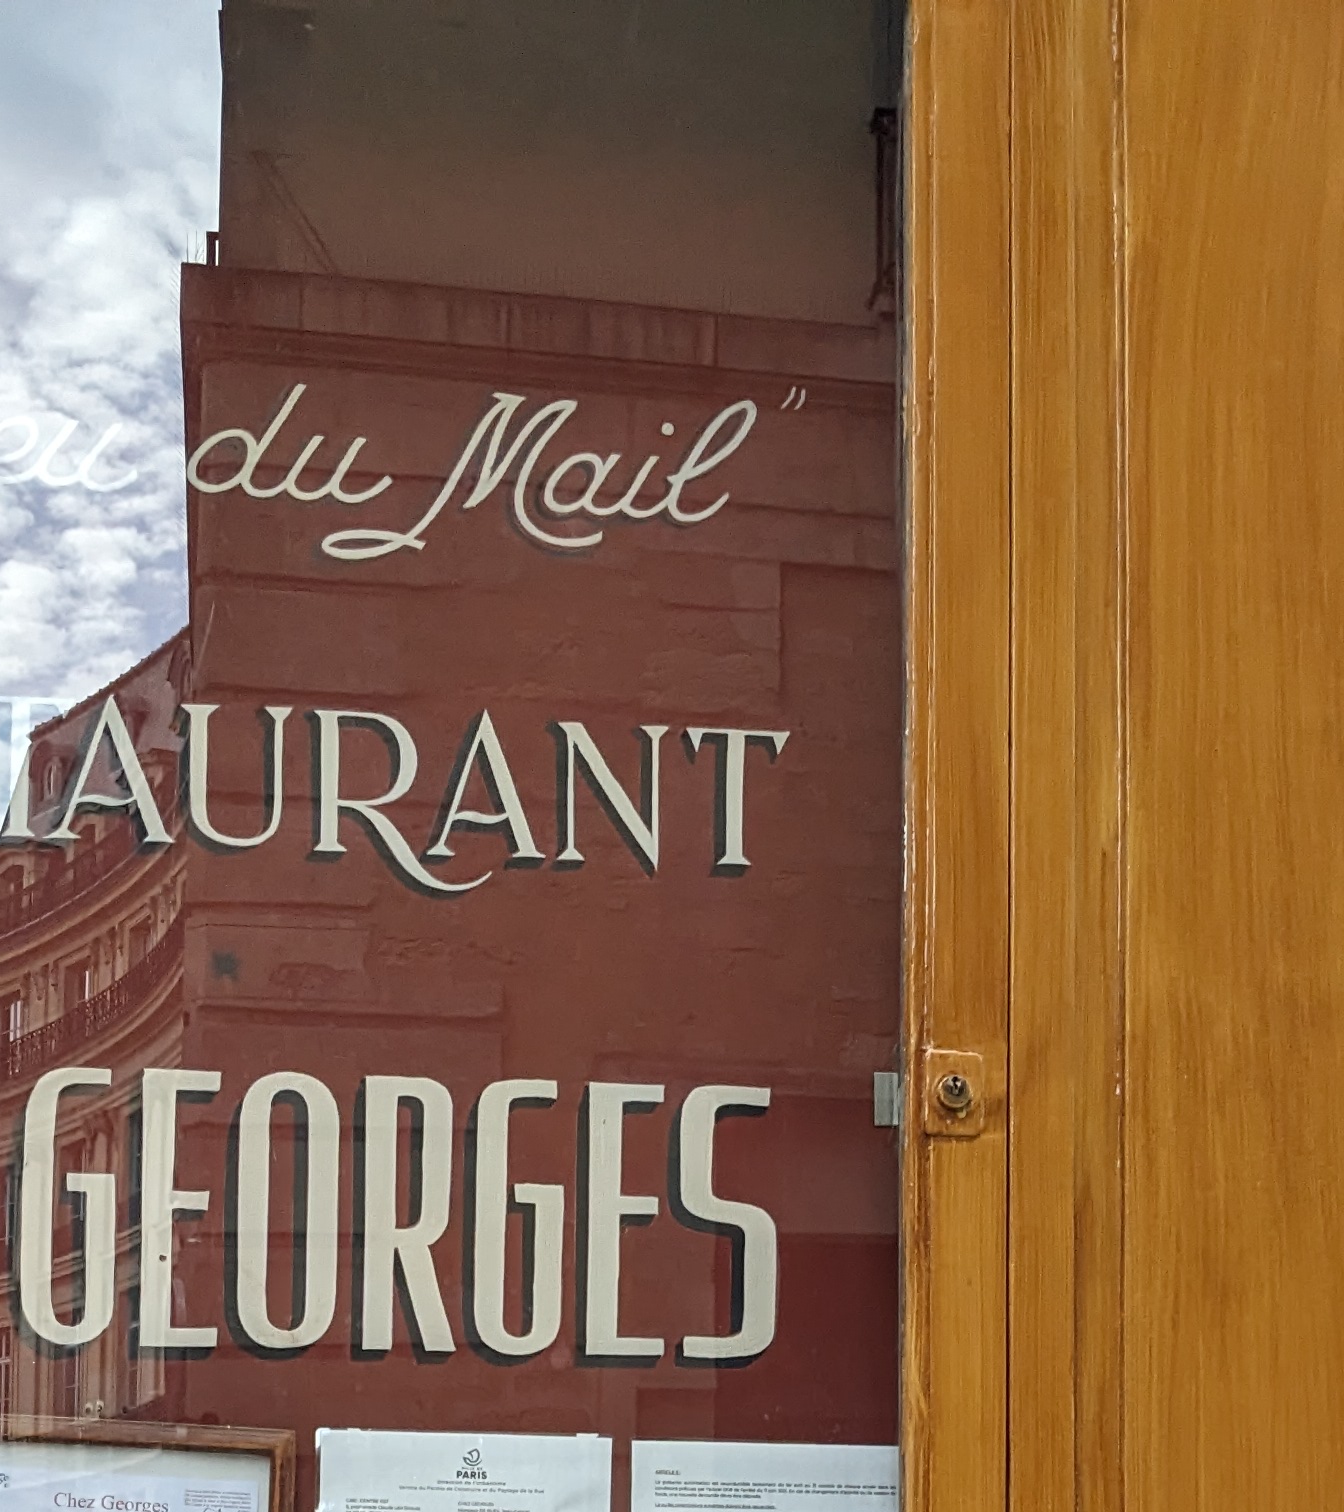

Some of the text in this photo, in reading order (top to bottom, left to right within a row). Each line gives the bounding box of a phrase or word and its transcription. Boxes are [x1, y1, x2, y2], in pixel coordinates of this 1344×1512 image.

[185, 382, 394, 503] du
[18, 1066, 779, 1361] GEORGES
[54, 1492, 96, 1508] Chez
[456, 1471, 487, 1480] PARIS
